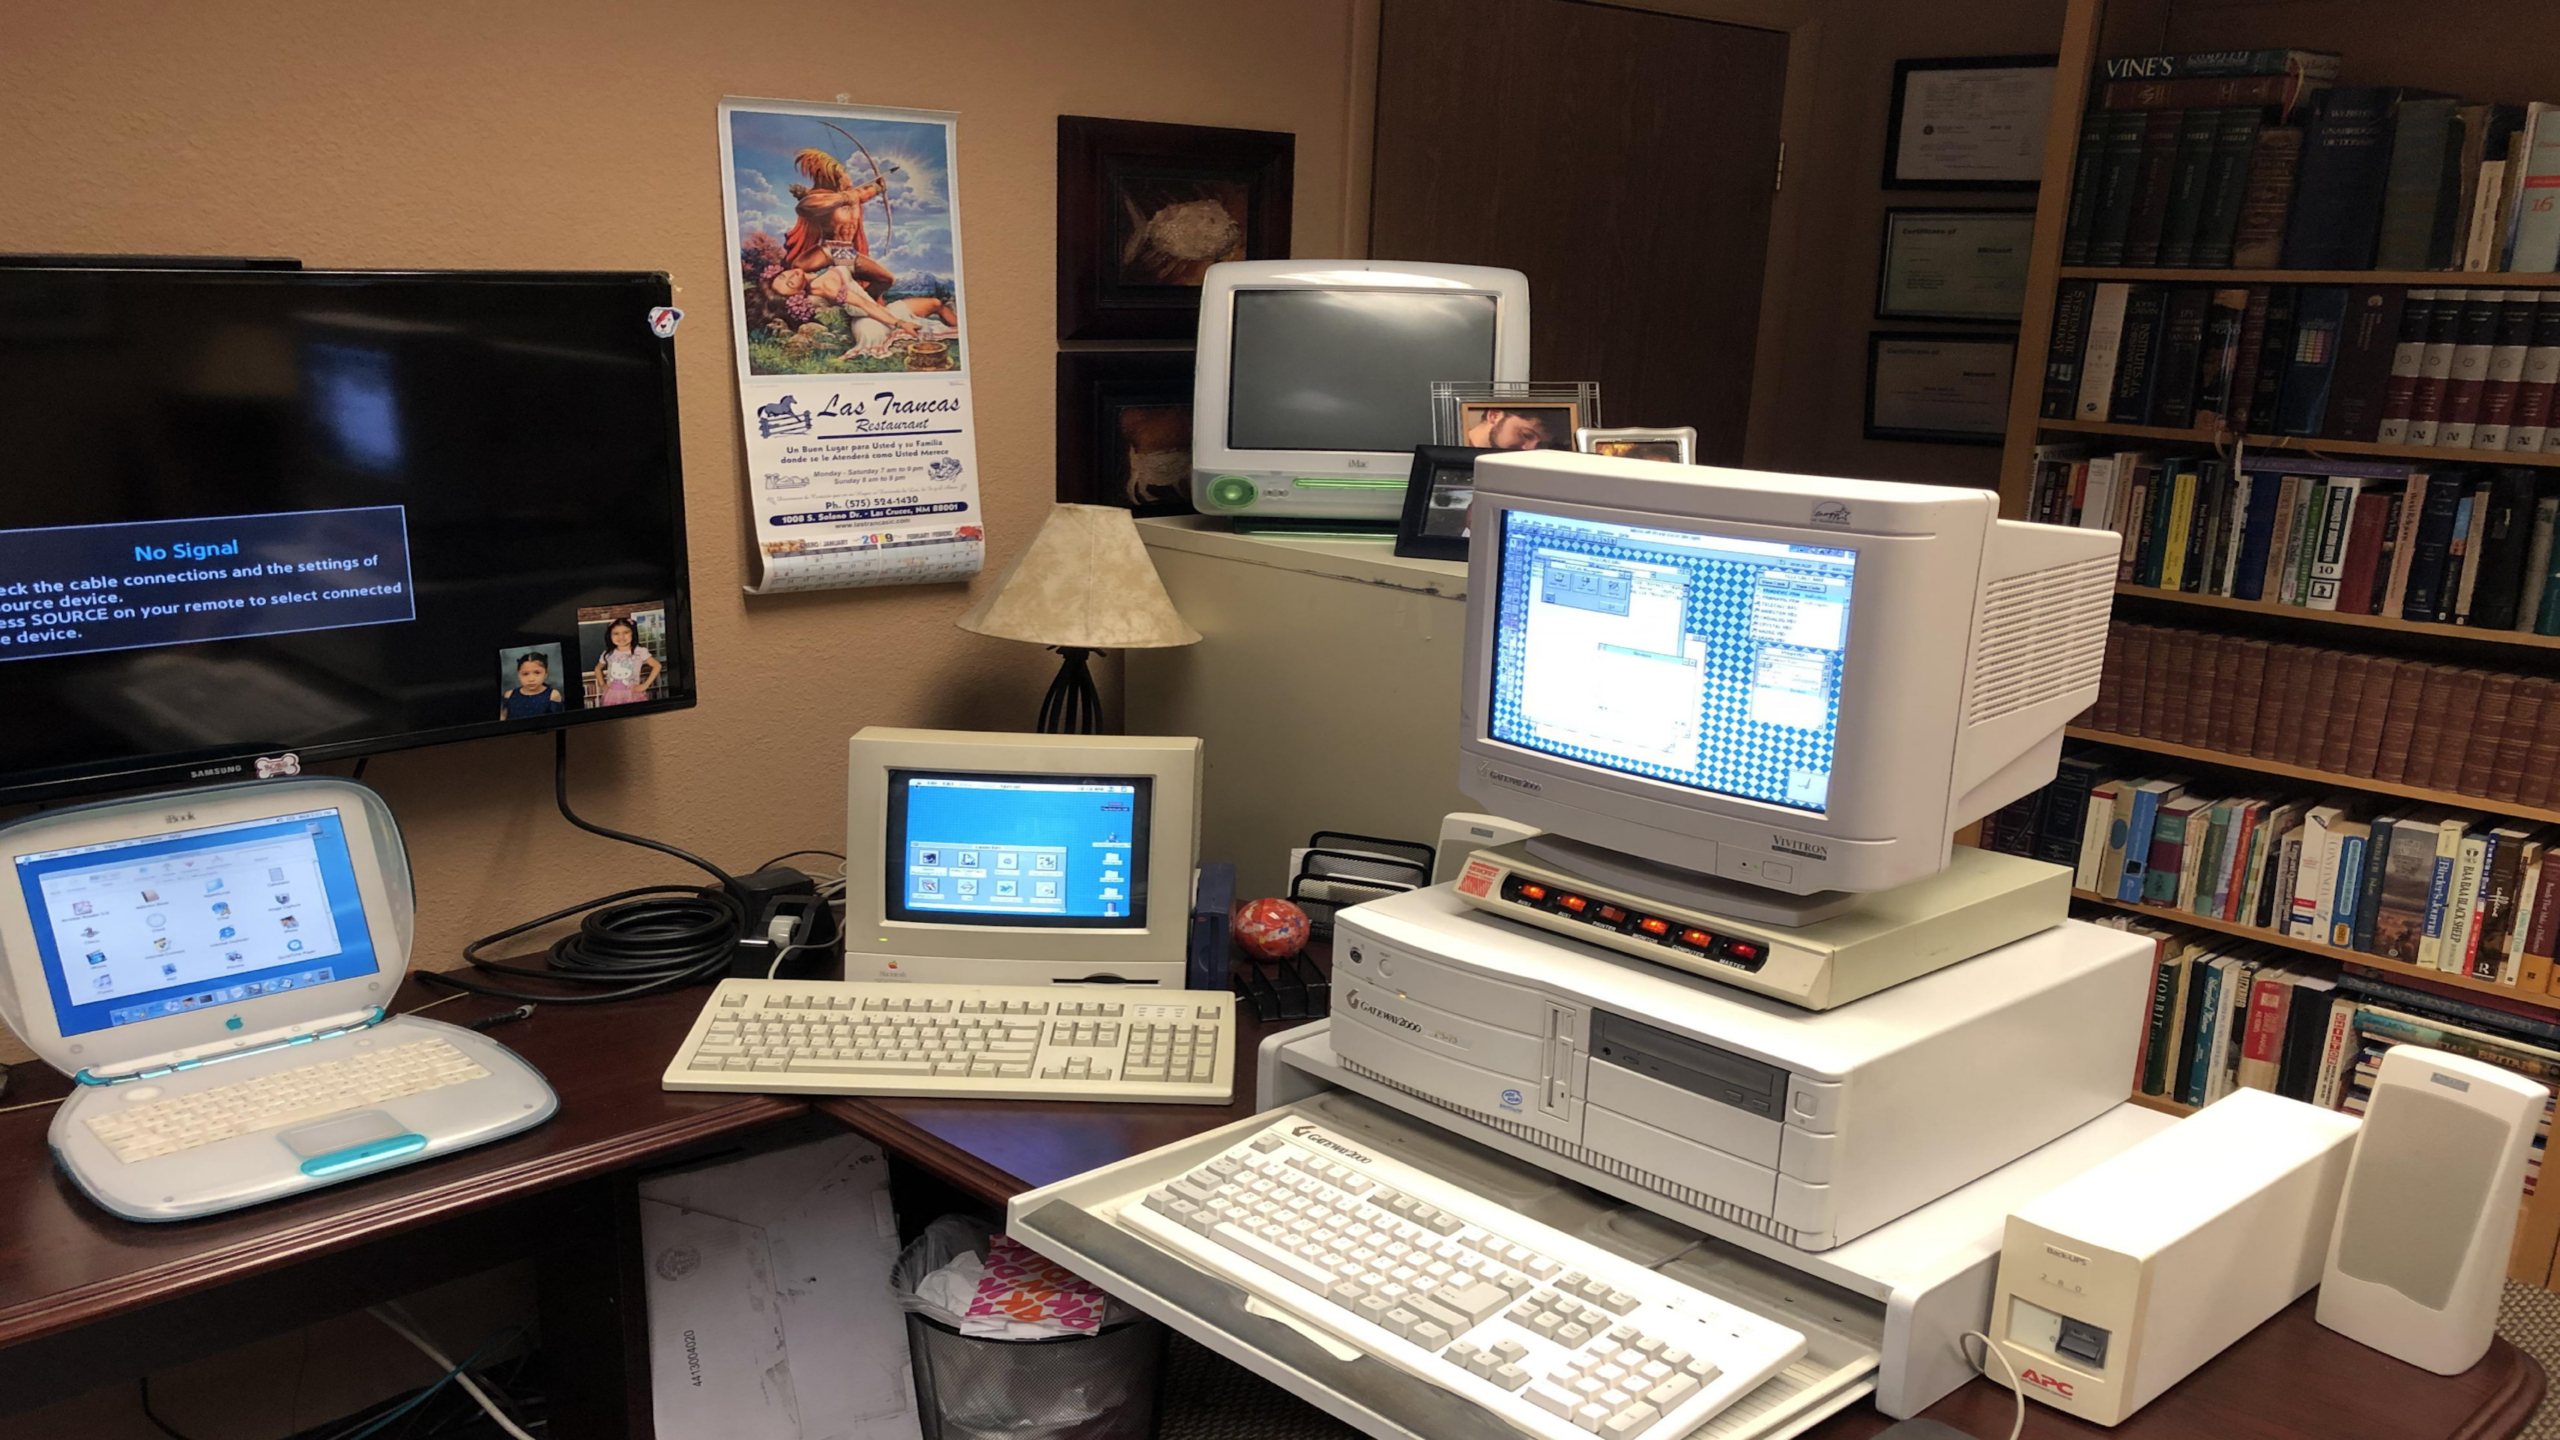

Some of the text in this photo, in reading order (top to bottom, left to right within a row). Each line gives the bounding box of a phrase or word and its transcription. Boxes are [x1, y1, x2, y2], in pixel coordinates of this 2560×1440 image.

[2106, 56, 2174, 78] VINE'S
[2530, 196, 2555, 212] 16
[2053, 293, 2074, 351] THEOLOGY
[2064, 290, 2086, 357] SYSTEMATIC
[2133, 323, 2151, 378] INSTITUTES
[817, 391, 961, 417] Las Trancas
[855, 418, 930, 434] Restaurant
[786, 446, 800, 454] Un
[802, 445, 824, 453] Buen
[826, 444, 849, 453] Lugar
[851, 443, 870, 453] para
[872, 441, 895, 450] Usted
[898, 442, 903, 450] y
[916, 438, 943, 447] Familia
[780, 455, 808, 464] donde
[810, 455, 819, 463] se
[821, 454, 830, 462] le
[872, 451, 893, 459] como
[895, 450, 918, 458] Usted
[921, 448, 950, 456] Merece
[1348, 459, 1369, 468] iMac
[813, 470, 842, 478] Monday
[847, 467, 879, 477] Saturday
[913, 466, 924, 474] pm
[834, 476, 860, 485] Sunday
[825, 502, 842, 510] Ph.
[845, 498, 871, 509] (575)
[874, 495, 919, 506] 524-1430
[781, 503, 958, 524] 1008 S. Solano Dr. Las Cruces, NM 88001
[823, 539, 848, 547] JANUARY
[861, 533, 894, 545] 2019
[135, 539, 239, 562] No Signal
[33, 579, 65, 594] the
[70, 575, 118, 590] cable
[123, 568, 228, 587] connections
[232, 564, 262, 579] and
[267, 561, 294, 575] the
[298, 555, 360, 574] settings
[363, 554, 379, 567] of
[2318, 566, 2333, 575] 10
[31, 608, 108, 627] SOURCE
[113, 607, 136, 620] on
[141, 603, 180, 621] your
[185, 598, 245, 614] remote
[249, 595, 267, 608] to
[271, 589, 318, 606] select
[322, 582, 402, 601] connected
[59, 592, 124, 608] device.
[17, 627, 83, 644] device.
[190, 764, 242, 778] SAMSUNG
[164, 811, 196, 825] iBook
[1772, 834, 1829, 855] VIVITRON
[2426, 860, 2450, 938] Birder's Journal
[2451, 866, 2475, 943] BAA BAA BLACK SHEEP
[1592, 920, 1617, 932] PRINTER
[1632, 933, 1659, 945] MONITOR
[1671, 944, 1705, 958] COMPUTER
[1719, 958, 1746, 970] MASTER
[2478, 963, 2490, 975] R
[2154, 973, 2169, 1028] HOBBIT
[1360, 1000, 1422, 1034] GATEWAY2000
[2467, 1007, 2536, 1030] ANCESTRY
[2327, 1012, 2347, 1066] CHILTON
[1307, 1133, 1372, 1164] GATEWAY2000
[2046, 1246, 2087, 1267] Back-UPS
[684, 1330, 702, 1387] 4413004020
[2021, 1369, 2074, 1397] APC
